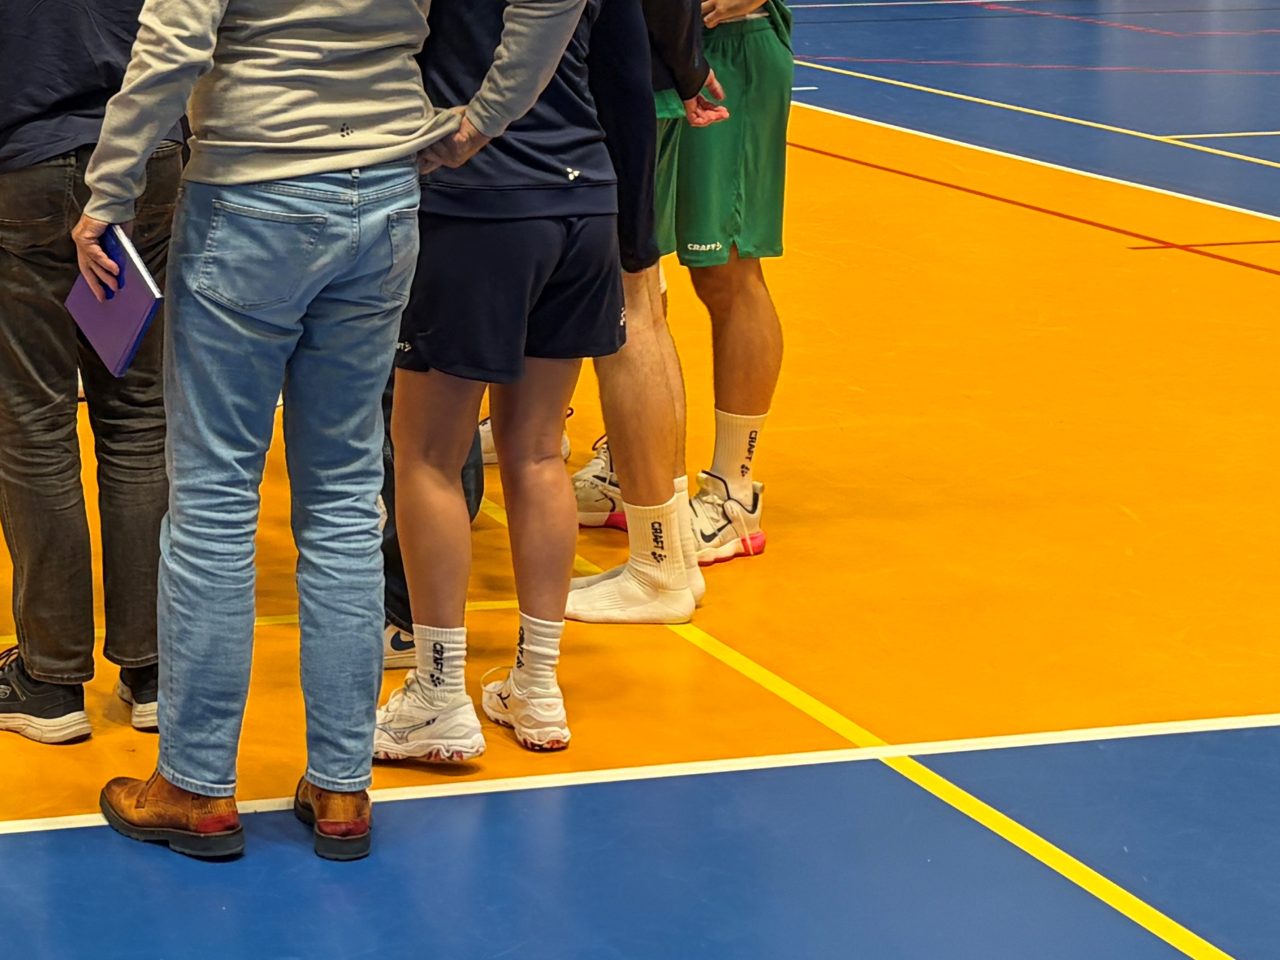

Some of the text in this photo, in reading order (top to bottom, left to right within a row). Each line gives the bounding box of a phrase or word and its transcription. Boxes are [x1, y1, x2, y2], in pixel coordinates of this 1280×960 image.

[687, 243, 716, 251] CRAFT
[745, 430, 758, 461] CRAFT
[651, 521, 664, 551] CRAFT
[433, 642, 444, 673] CRAFT
